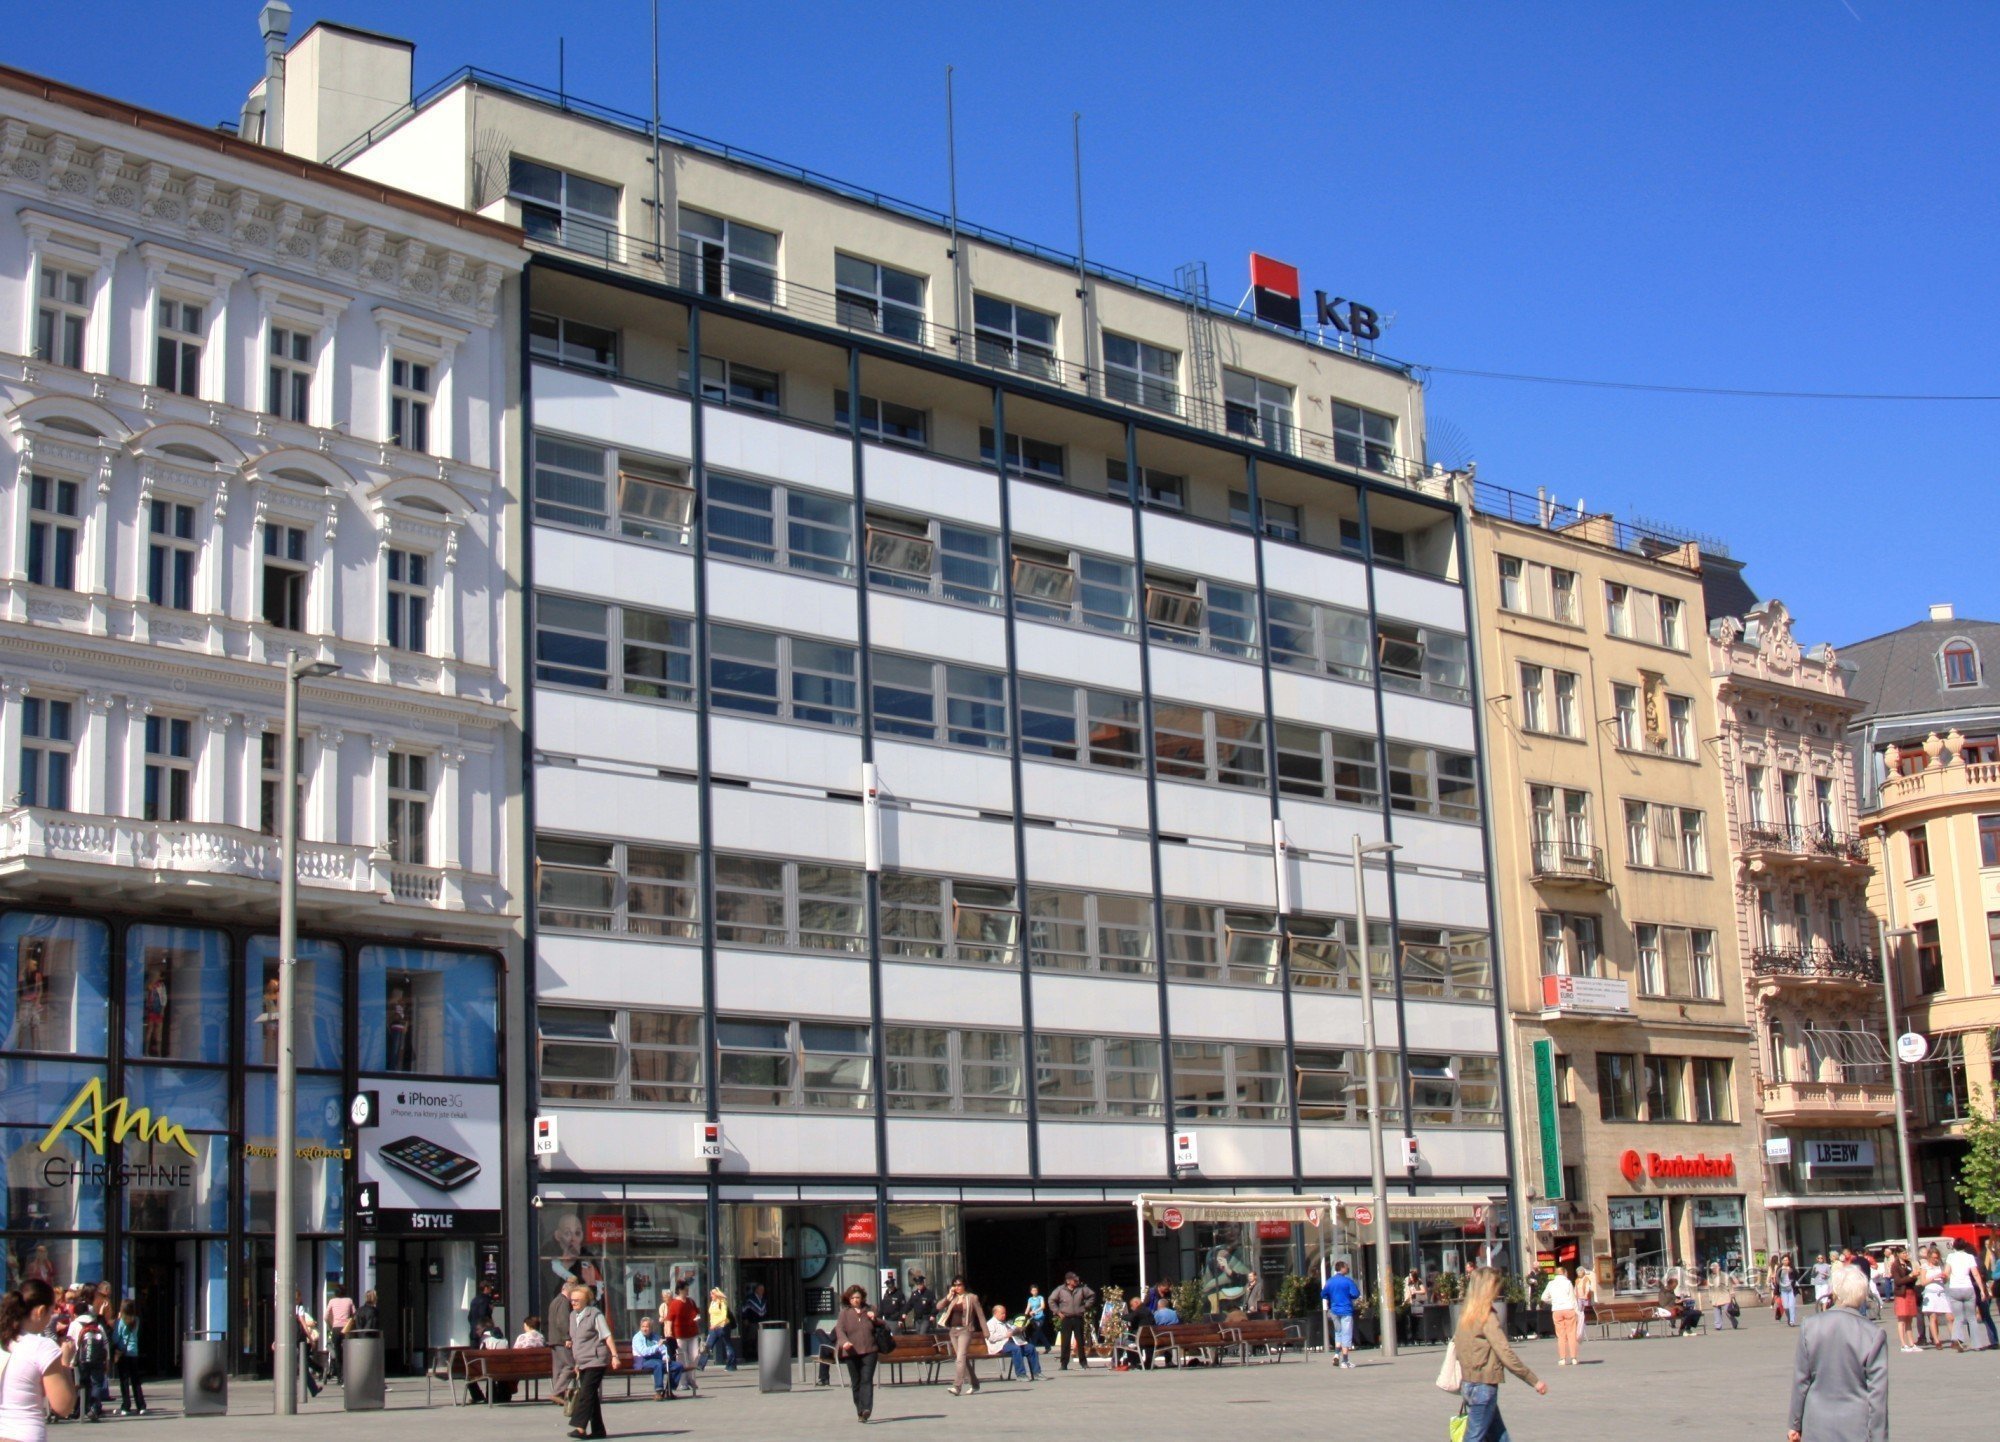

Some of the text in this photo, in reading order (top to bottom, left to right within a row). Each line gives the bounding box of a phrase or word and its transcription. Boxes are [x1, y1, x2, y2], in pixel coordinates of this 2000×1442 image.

[1314, 289, 1381, 340] KB
[409, 1092, 463, 1108] iPhone 3G
[537, 1140, 552, 1151] KB
[702, 1145, 721, 1155] KB
[1178, 1152, 1193, 1160] KB
[1408, 1155, 1420, 1164] KB
[43, 1156, 191, 1188] CHRISTINE
[1647, 1153, 1733, 1178] Bontonland
[411, 1212, 453, 1228] iSTYLE
